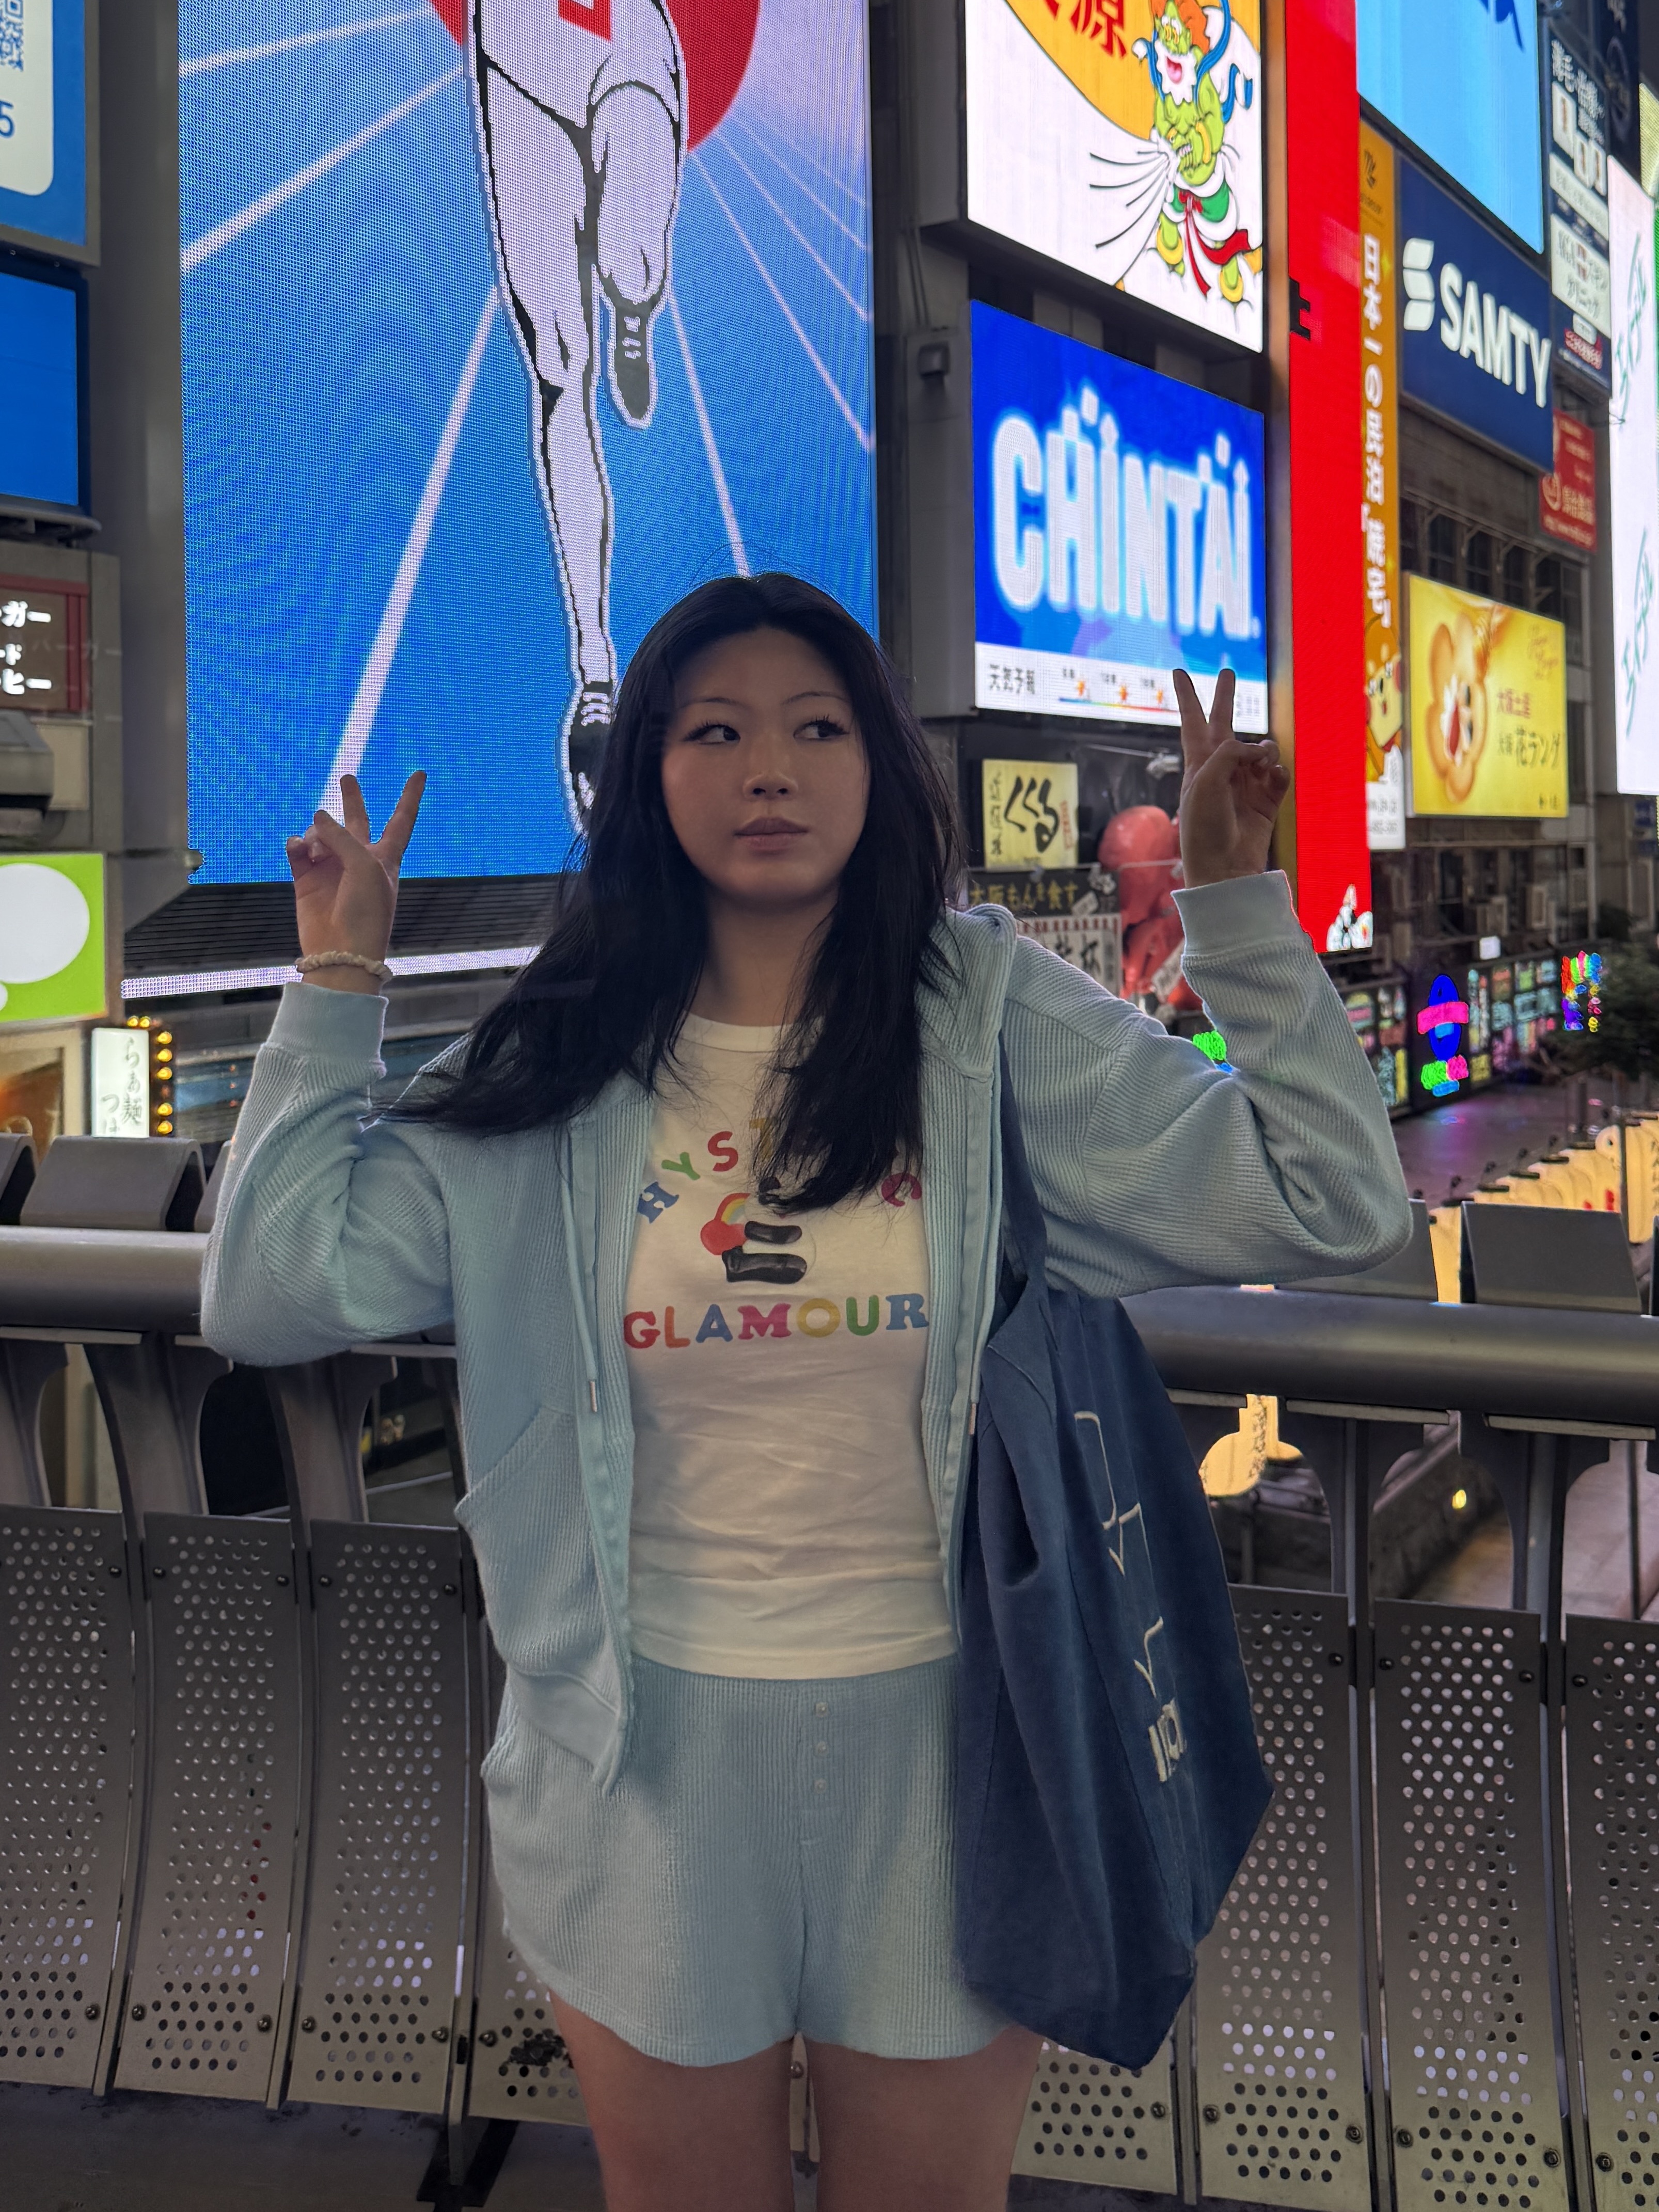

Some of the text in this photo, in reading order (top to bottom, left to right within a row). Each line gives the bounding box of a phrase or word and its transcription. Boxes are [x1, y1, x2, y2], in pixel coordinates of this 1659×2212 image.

[1440, 262, 1552, 409] SAMTY
[0, 600, 52, 628] ガー
[0, 668, 52, 695] ヒー
[623, 1293, 929, 1349] GLAMOUR
